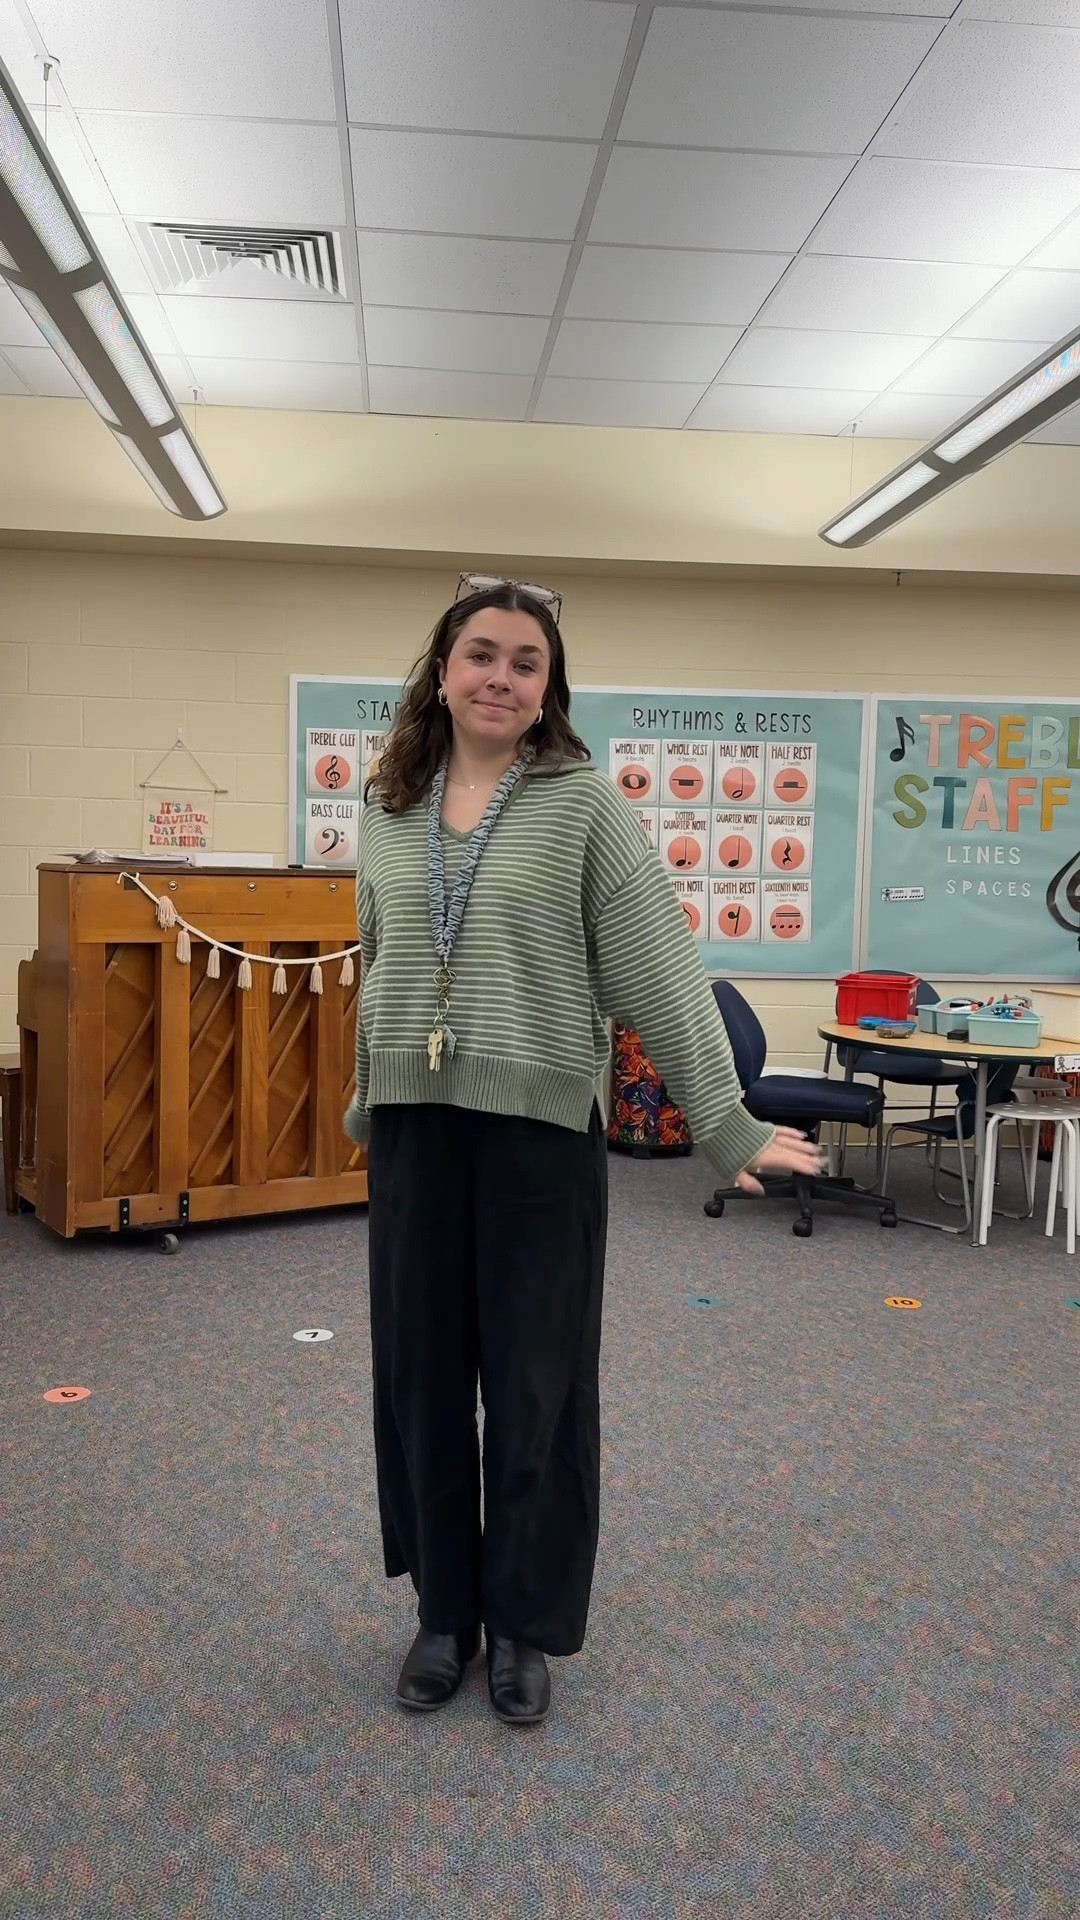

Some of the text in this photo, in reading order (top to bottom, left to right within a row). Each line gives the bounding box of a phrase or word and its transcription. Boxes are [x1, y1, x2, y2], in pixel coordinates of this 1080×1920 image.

[632, 708, 813, 734] RHYTHMS & RESTS
[310, 732, 357, 748] TREBLE CLEF
[615, 743, 656, 755] WHOLE NOTE
[666, 743, 709, 756] WHOLE REST
[719, 744, 760, 759] HALF NOTE
[771, 746, 813, 760] HALF REST
[160, 802, 193, 815] IT'S A
[892, 774, 1072, 832] STAFF
[311, 804, 353, 819] BASS CLEF
[675, 811, 695, 820] DOTTED
[149, 813, 208, 825] BEAUTIFUL
[639, 819, 652, 831] OTE
[663, 819, 706, 831] QUARTER NOTE
[716, 813, 758, 825] QUARTER NOTE
[768, 815, 811, 827] QUARTER REST
[153, 825, 176, 836] DAY
[149, 834, 207, 848] LEARNING
[947, 845, 1021, 864] LINES
[671, 880, 704, 892] HTH NOTE
[713, 882, 756, 895] EIGHTH REST
[765, 882, 809, 892] SIXTEENTH NOTES
[946, 879, 1031, 897] SPACES
[305, 1331, 318, 1339] 7
